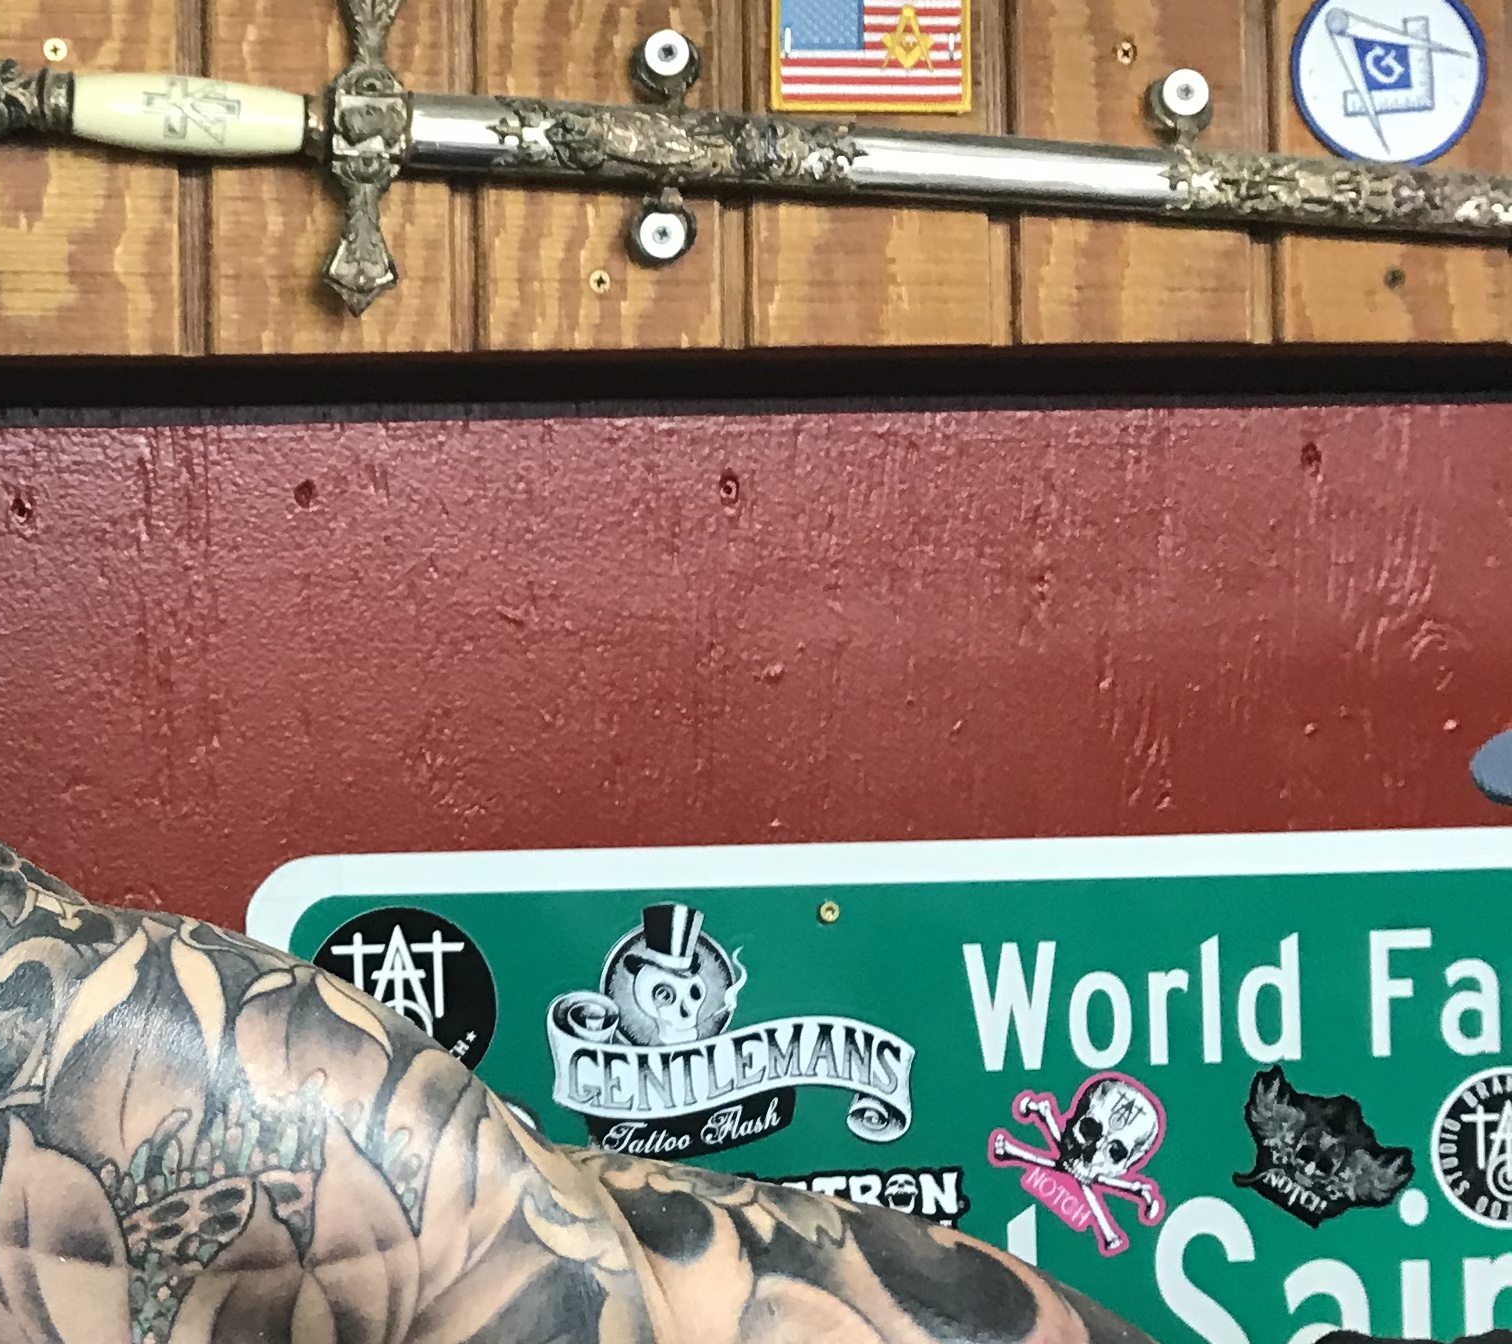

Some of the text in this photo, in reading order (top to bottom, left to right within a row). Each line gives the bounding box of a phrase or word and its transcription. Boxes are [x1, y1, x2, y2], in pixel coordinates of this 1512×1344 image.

[963, 928, 1501, 1073] World Fa
[568, 1022, 902, 1112] GENTLEMANS
[602, 1096, 781, 1154] Tattoo Flash
[1027, 1168, 1092, 1227] NOTCH
